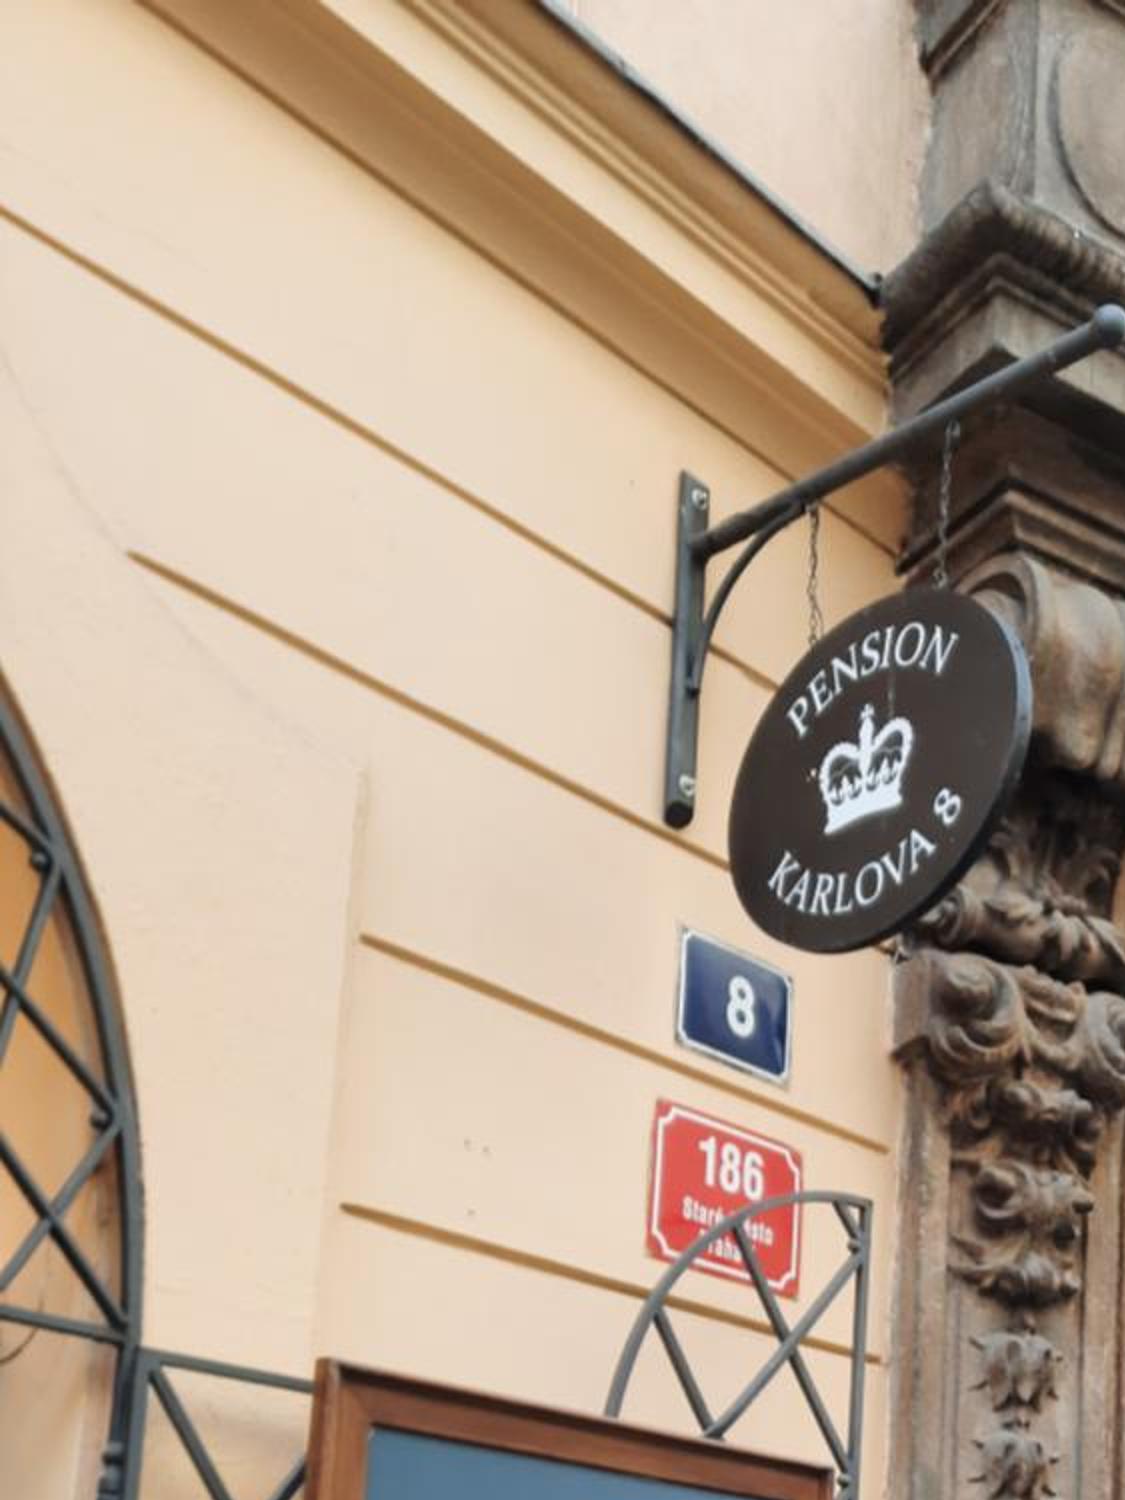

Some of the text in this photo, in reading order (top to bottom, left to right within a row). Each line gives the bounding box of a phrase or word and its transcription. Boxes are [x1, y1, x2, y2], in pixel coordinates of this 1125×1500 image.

[787, 621, 958, 739] PENSION
[768, 788, 961, 916] KARLOVA 8
[726, 975, 756, 1039] 8
[699, 1136, 765, 1202] 186
